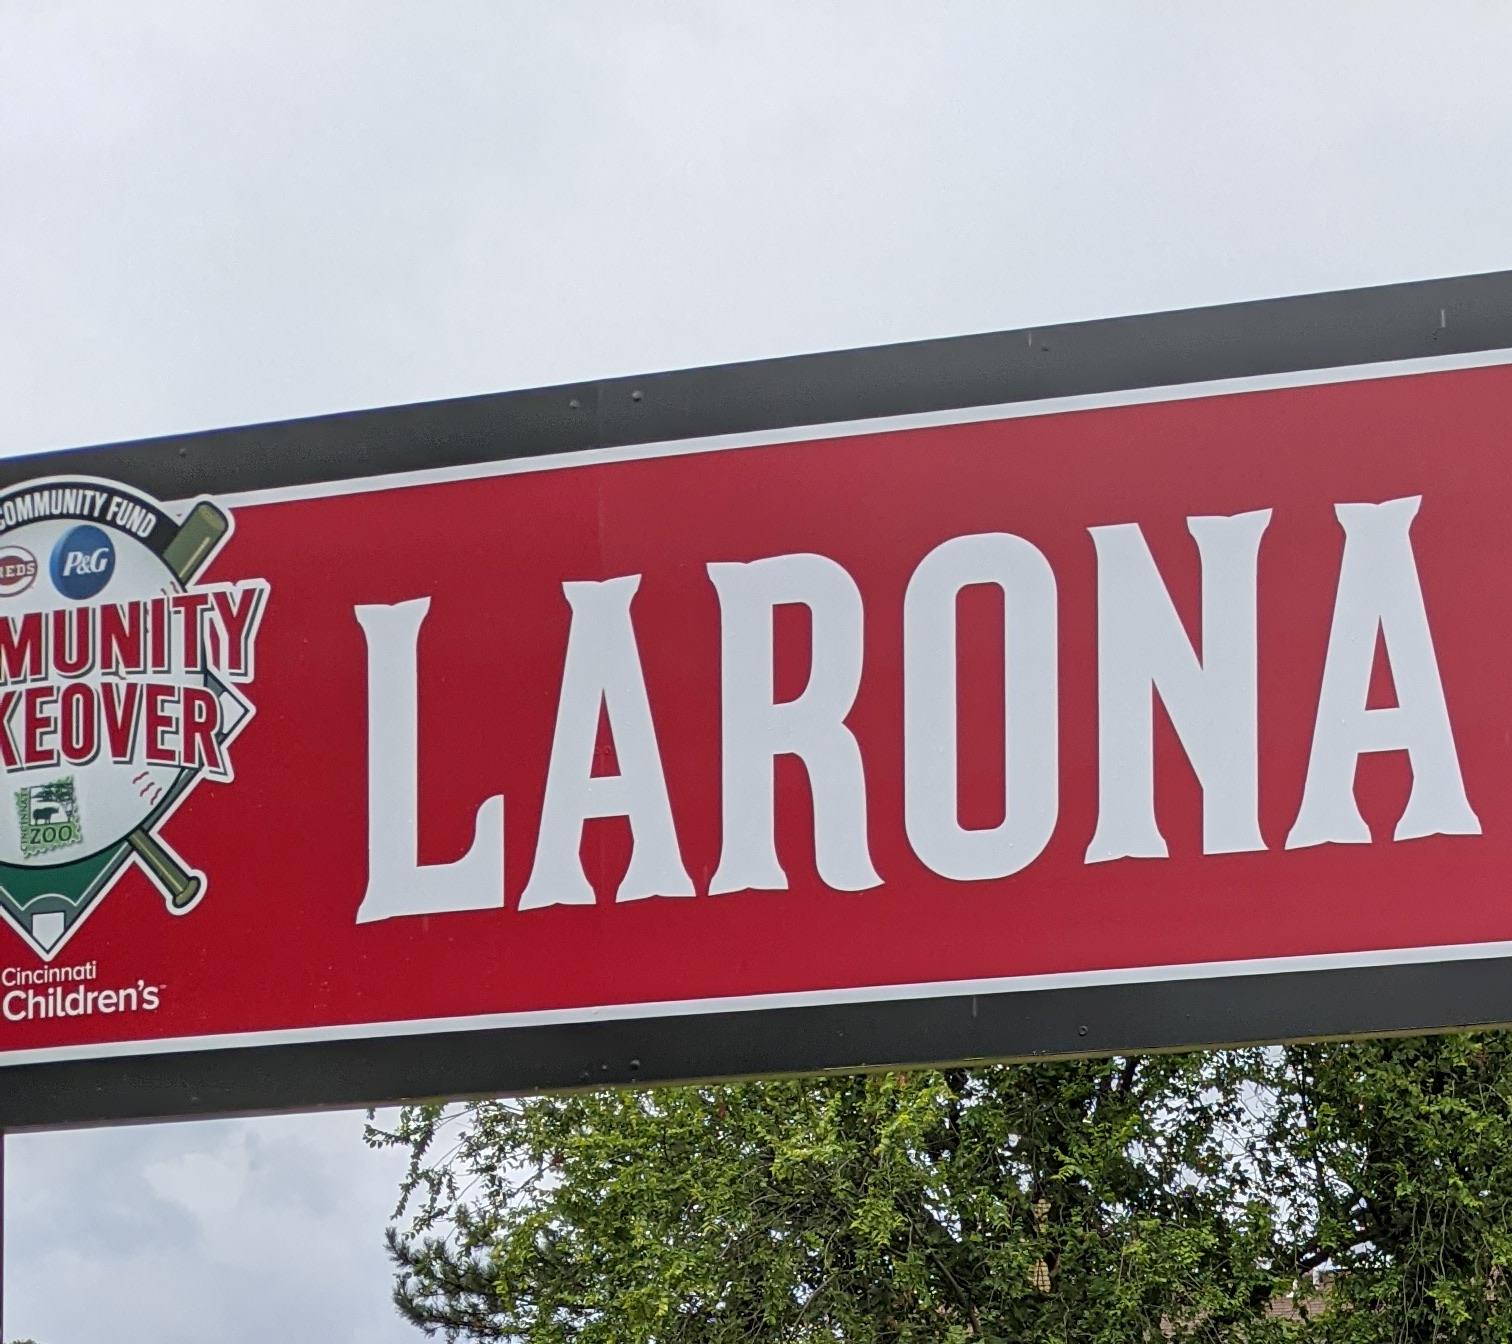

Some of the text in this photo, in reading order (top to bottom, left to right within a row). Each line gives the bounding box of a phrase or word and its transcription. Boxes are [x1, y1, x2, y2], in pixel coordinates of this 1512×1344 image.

[106, 497, 157, 538] FUND
[63, 547, 110, 577] P&G
[354, 495, 1482, 925] LARONA
[30, 825, 73, 845] ZOO
[1, 961, 97, 986] Cincinnati
[3, 980, 160, 1021] Children's
